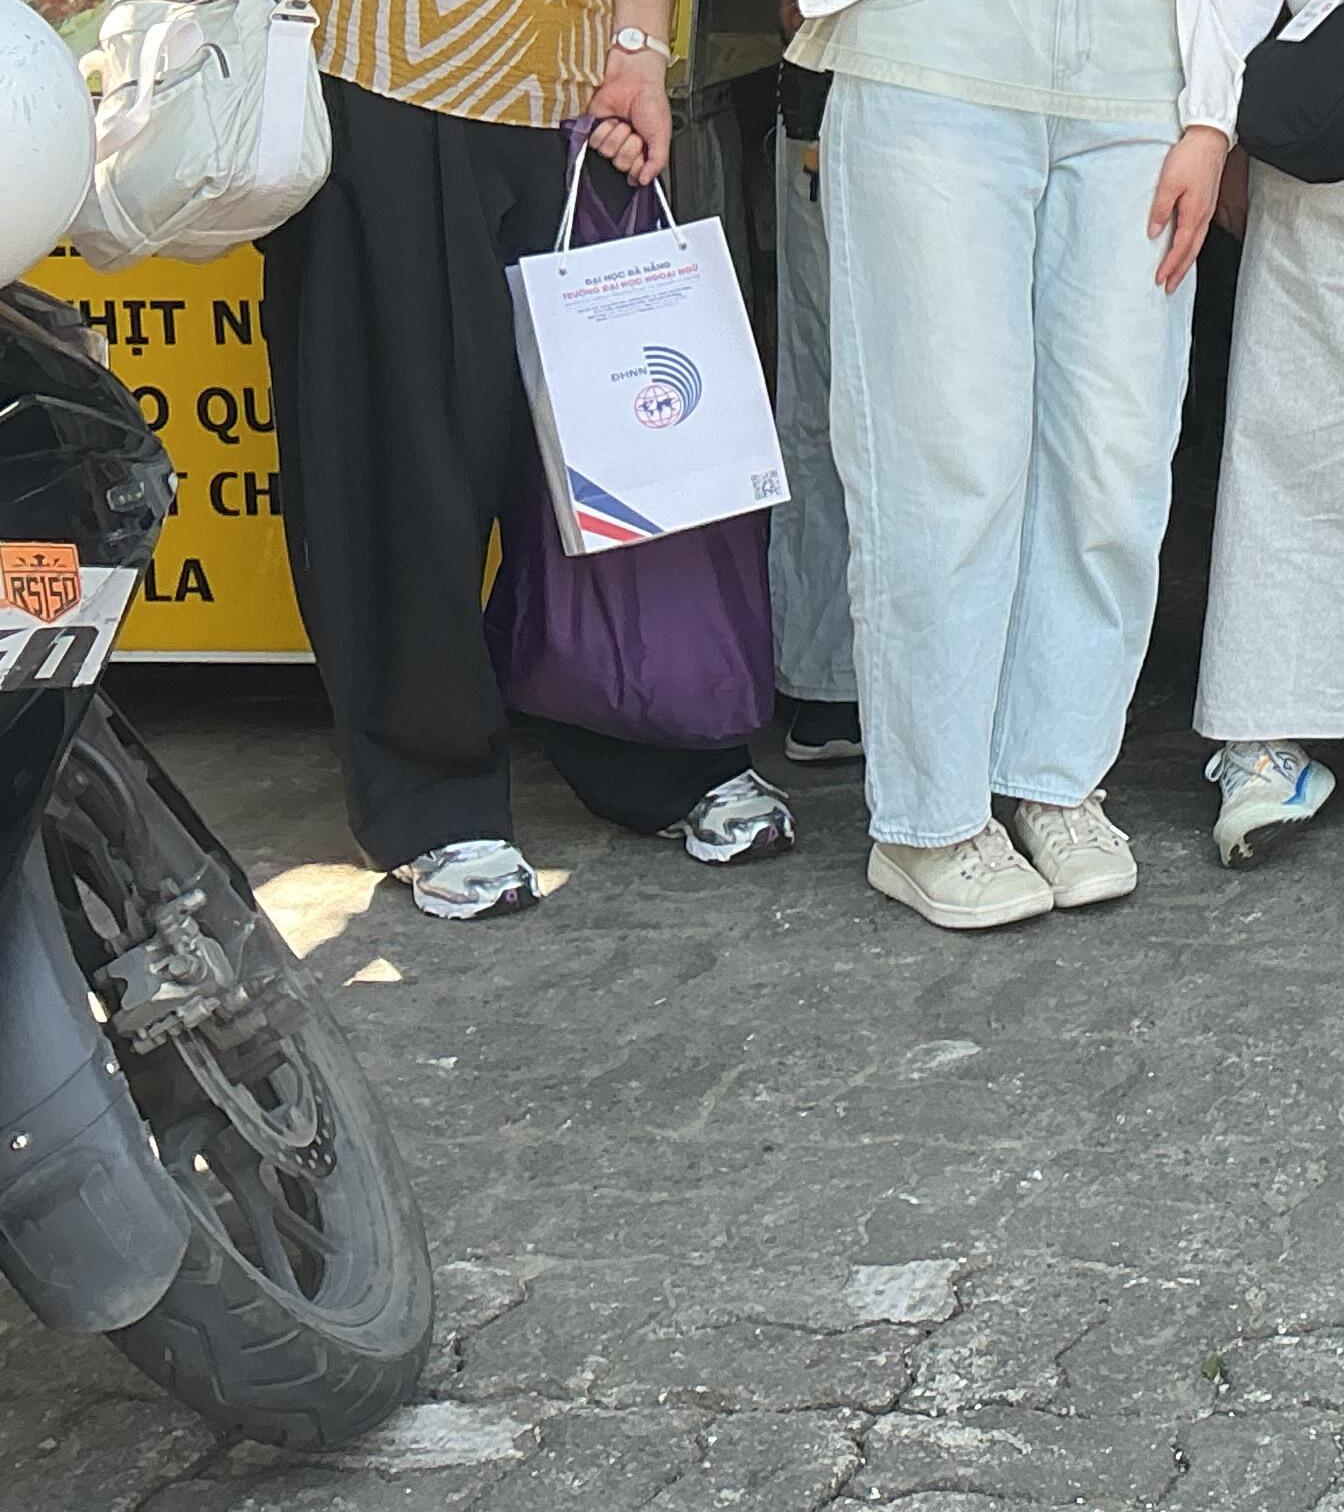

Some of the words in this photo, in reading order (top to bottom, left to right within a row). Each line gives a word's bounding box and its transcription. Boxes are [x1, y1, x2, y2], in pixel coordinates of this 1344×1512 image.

[78, 300, 185, 356] HỊT
[212, 300, 254, 345] N
[196, 387, 276, 444] QU
[209, 472, 281, 517] CH
[144, 558, 215, 603] LA
